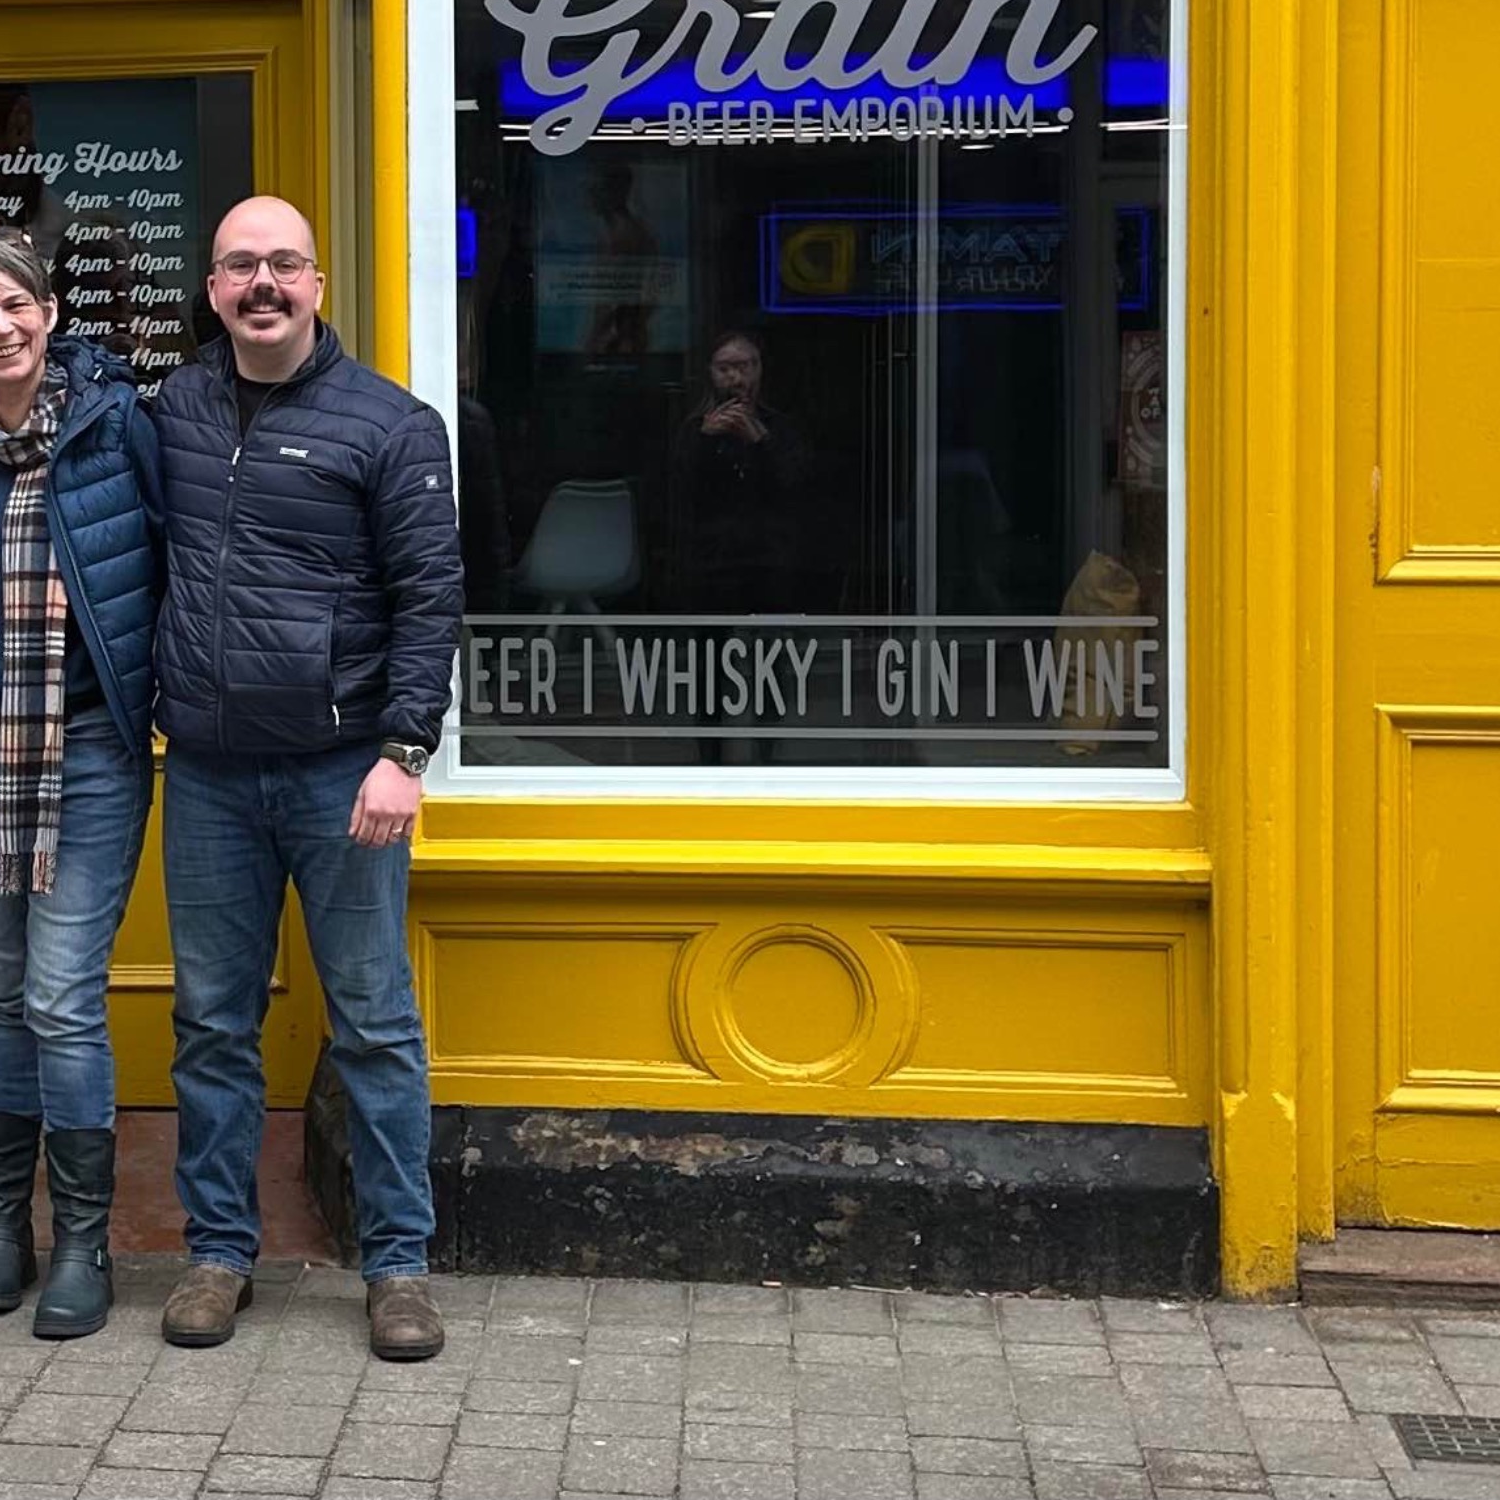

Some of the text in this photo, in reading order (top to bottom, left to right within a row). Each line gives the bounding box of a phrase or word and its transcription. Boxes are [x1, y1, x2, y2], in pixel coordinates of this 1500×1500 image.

[667, 93, 1036, 148] BEER EMPORIUM
[75, 142, 182, 177] Hours
[64, 190, 112, 213] 4pm
[127, 189, 184, 212] 10pm
[65, 222, 112, 244] 4pm
[128, 221, 184, 243] 10pm
[65, 254, 113, 276] 4pm
[128, 252, 184, 275] 10pm
[66, 285, 114, 308] 4pm
[129, 284, 186, 307] 10pm
[129, 316, 184, 338] 11pm
[130, 348, 184, 370] 11pm
[469, 636, 557, 715] EER
[616, 637, 818, 717] WHISKY
[877, 638, 960, 717] GIN
[1023, 638, 1160, 718] WINE
